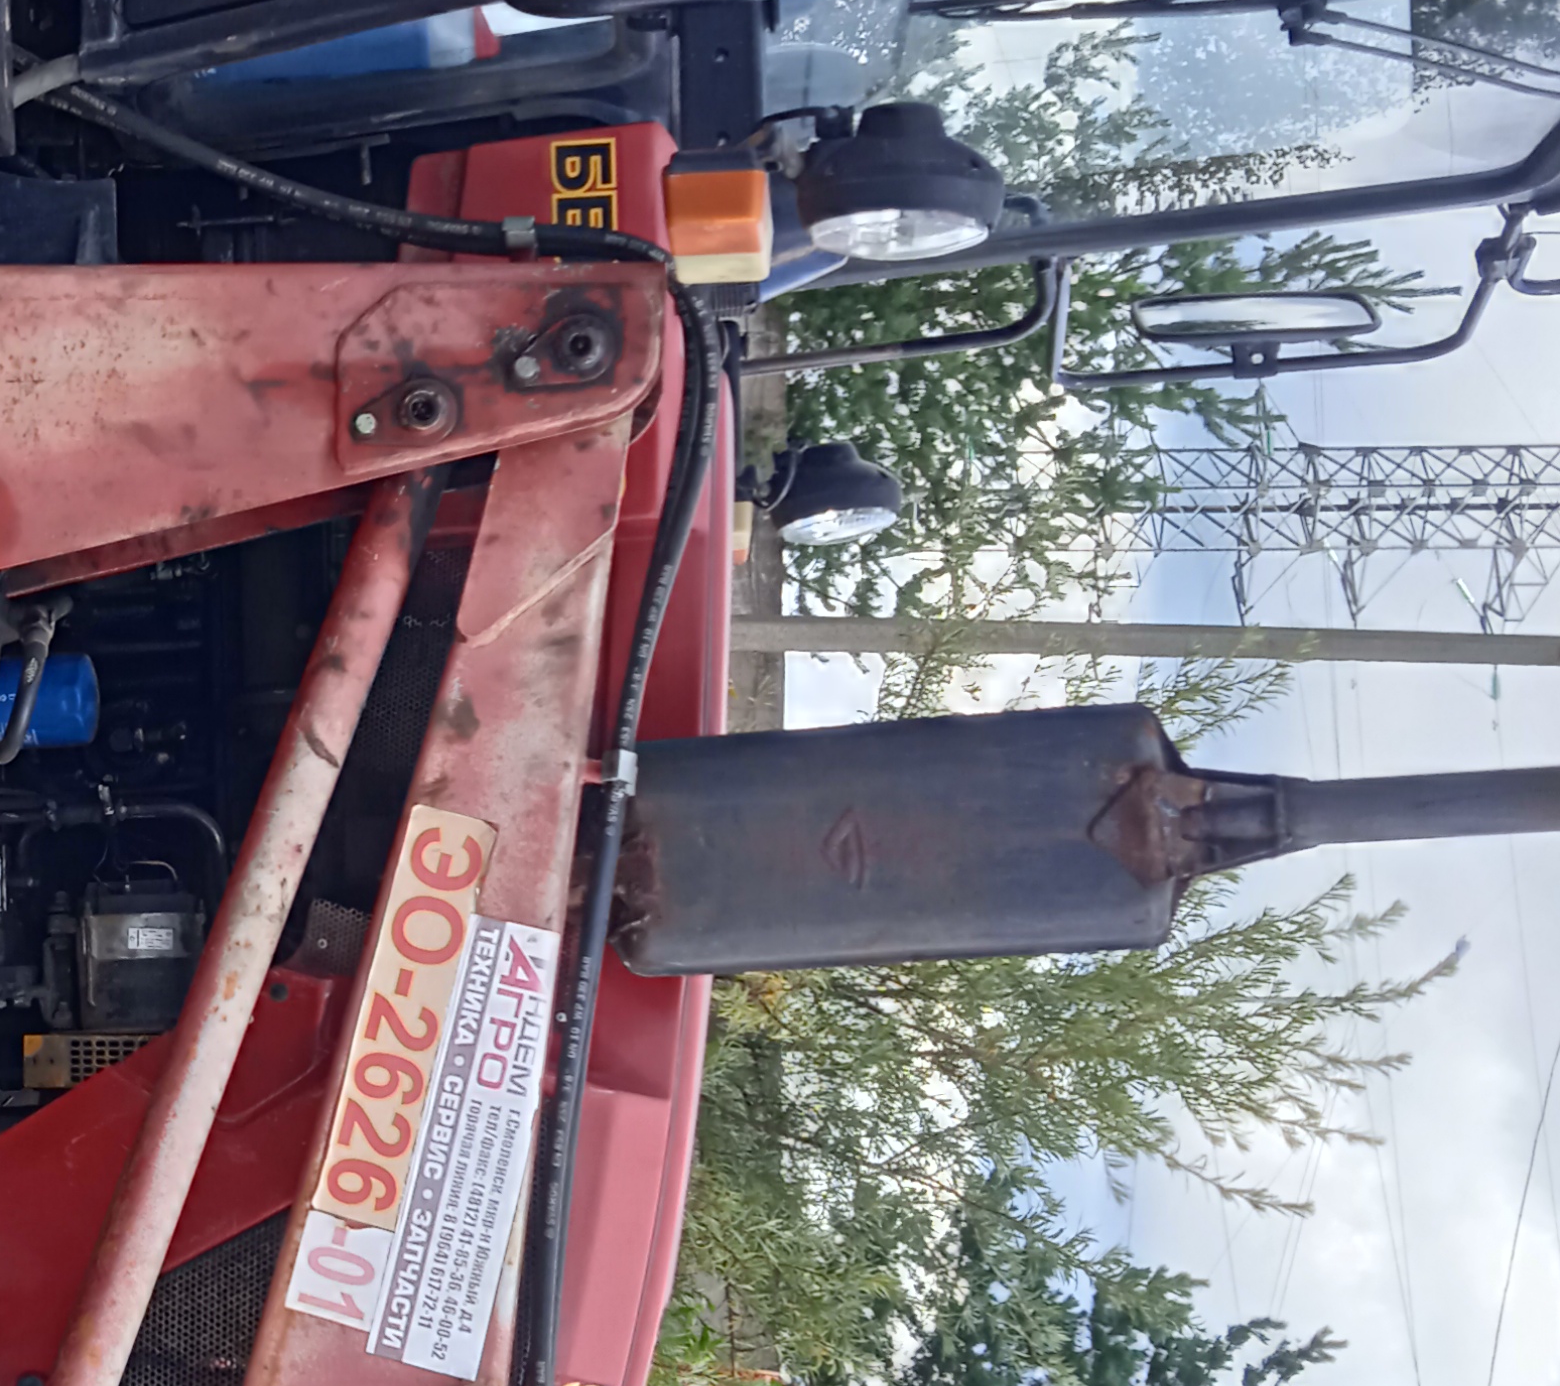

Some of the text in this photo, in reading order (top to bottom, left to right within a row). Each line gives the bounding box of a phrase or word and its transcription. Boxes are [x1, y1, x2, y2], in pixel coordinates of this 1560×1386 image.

[382, 927, 500, 1350] ТЕХНИКА СЕРВИС ЗАПЧАСТИ
[459, 1098, 483, 1160] горячая
[442, 1213, 457, 1225] 8
[417, 1266, 446, 1330] 617-72-11
[430, 1295, 457, 1361] 46-00-52
